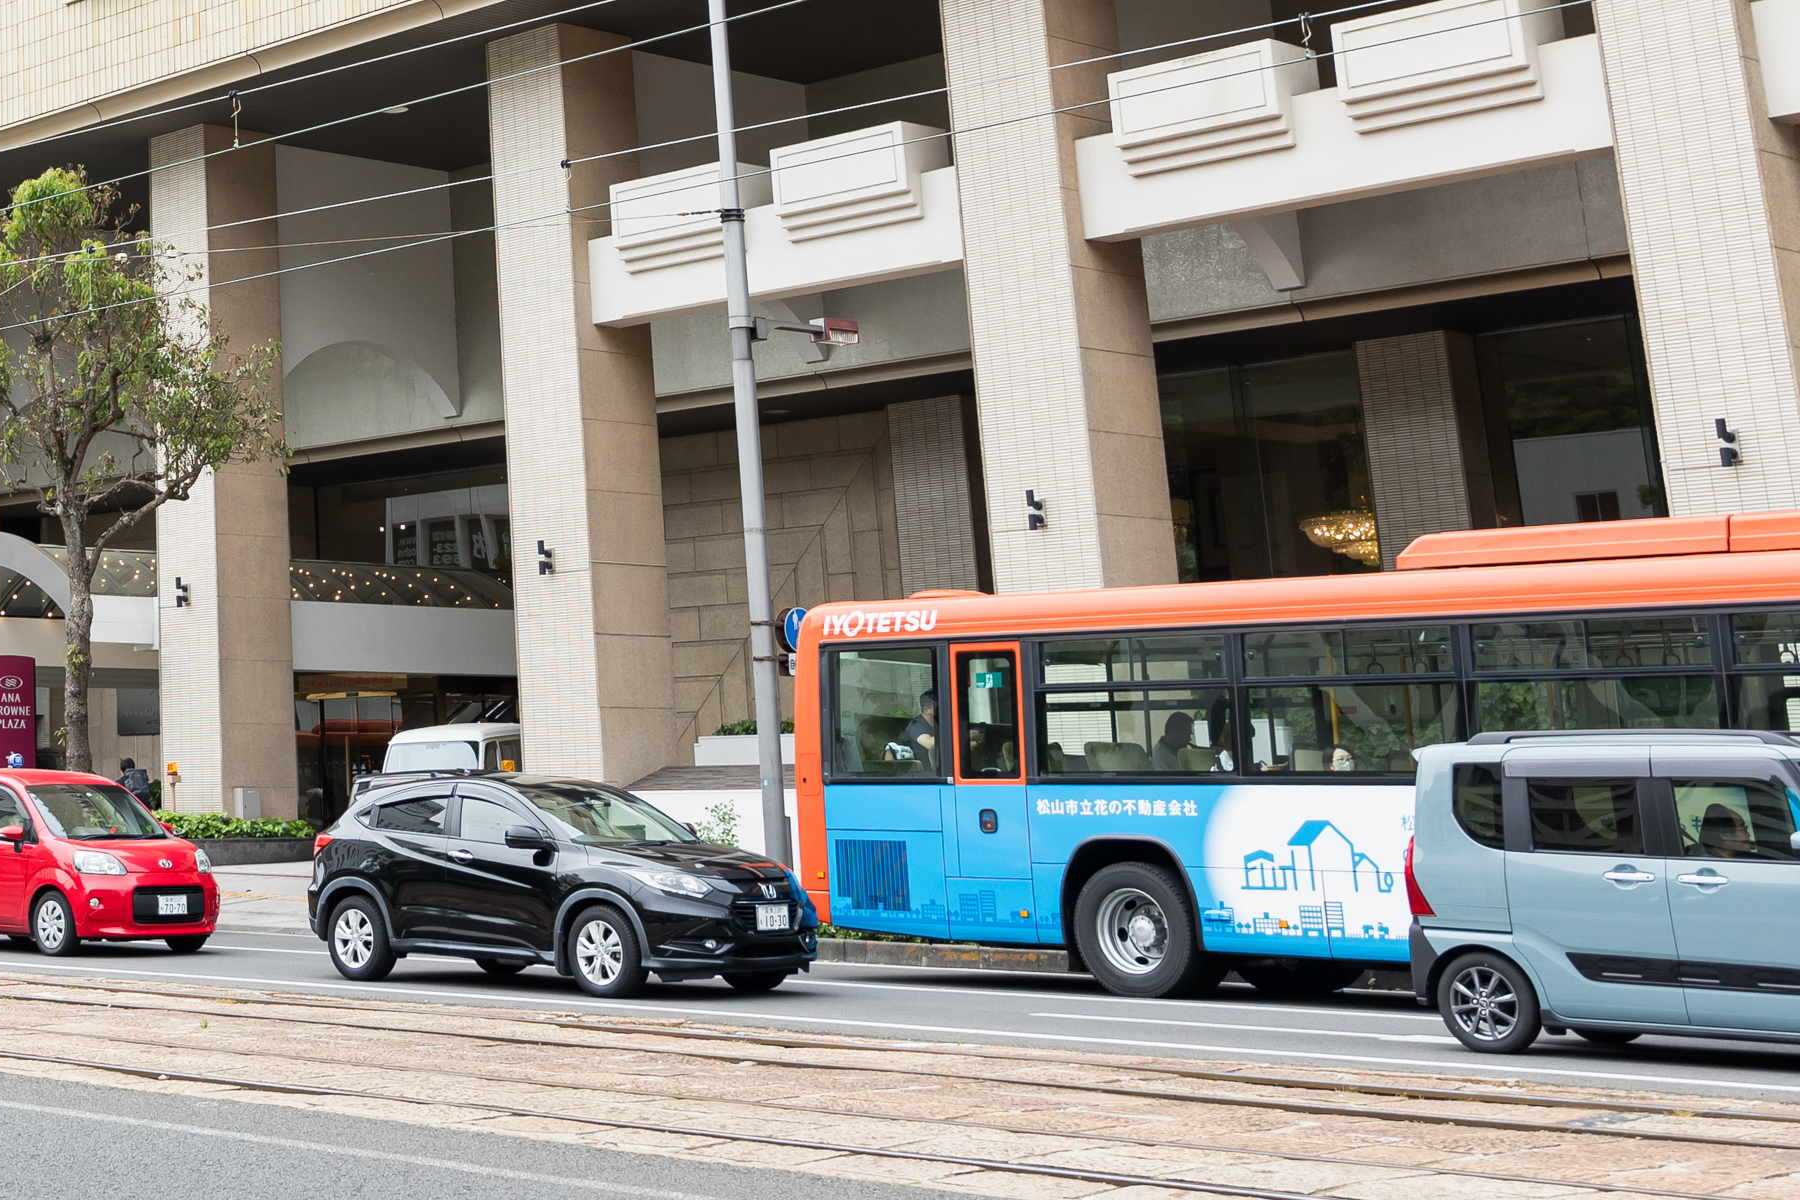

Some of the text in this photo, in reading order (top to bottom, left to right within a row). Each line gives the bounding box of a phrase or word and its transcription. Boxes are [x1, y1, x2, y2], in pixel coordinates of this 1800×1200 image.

[822, 609, 939, 637] IYOTETSU
[1, 692, 21, 703] ANA
[1036, 798, 1199, 817] 松山市立花の不動産会社
[164, 903, 186, 914] 70-70
[765, 914, 787, 927] 10-30
